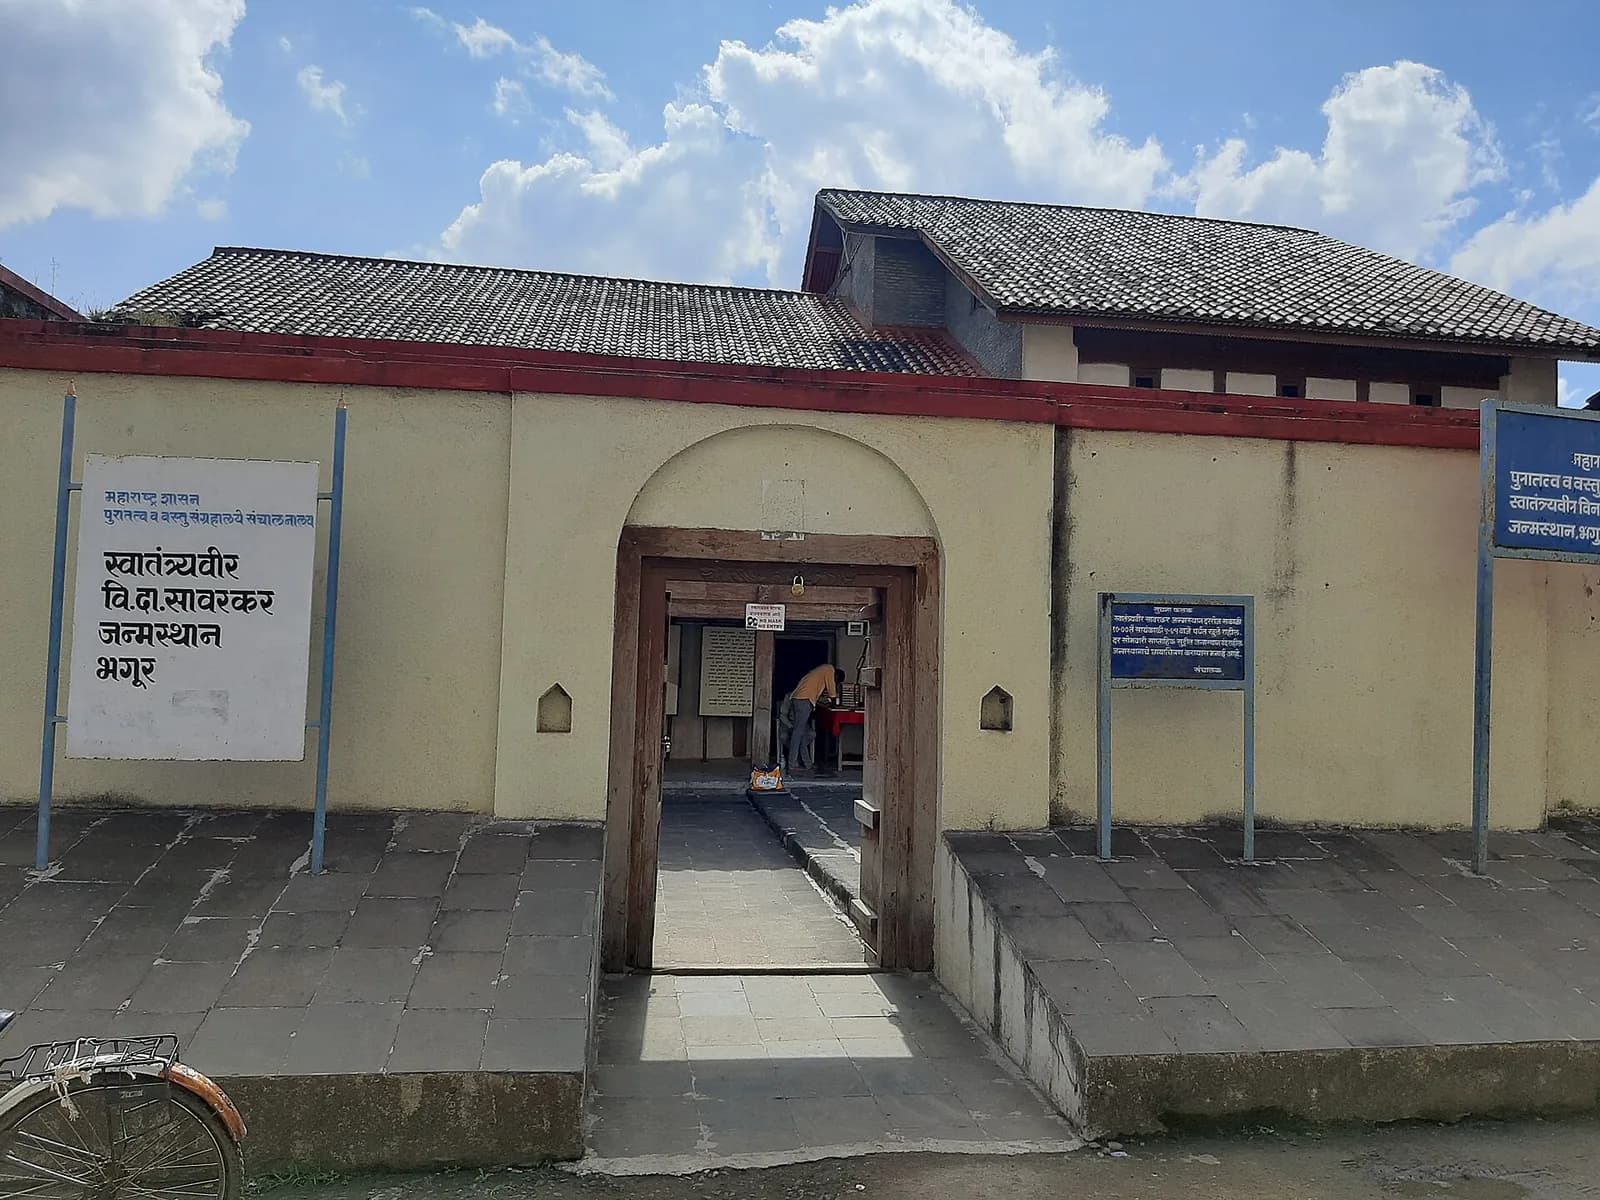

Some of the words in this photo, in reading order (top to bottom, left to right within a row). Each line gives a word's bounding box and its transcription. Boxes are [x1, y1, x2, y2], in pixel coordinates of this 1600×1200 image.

[1562, 476, 1572, 490] व
[105, 491, 157, 506] महाराष्ट्र
[161, 494, 200, 506] शासन
[104, 508, 148, 525] पुरातत्व
[150, 511, 159, 523] व
[161, 511, 190, 527] वस्तु
[190, 505, 244, 528] संग्रहालये
[246, 509, 314, 528] संचालनालय
[103, 546, 240, 580] स्वातंत्र्यवीर
[98, 621, 223, 648] जन्मस्थान
[96, 656, 157, 690] भगूर
